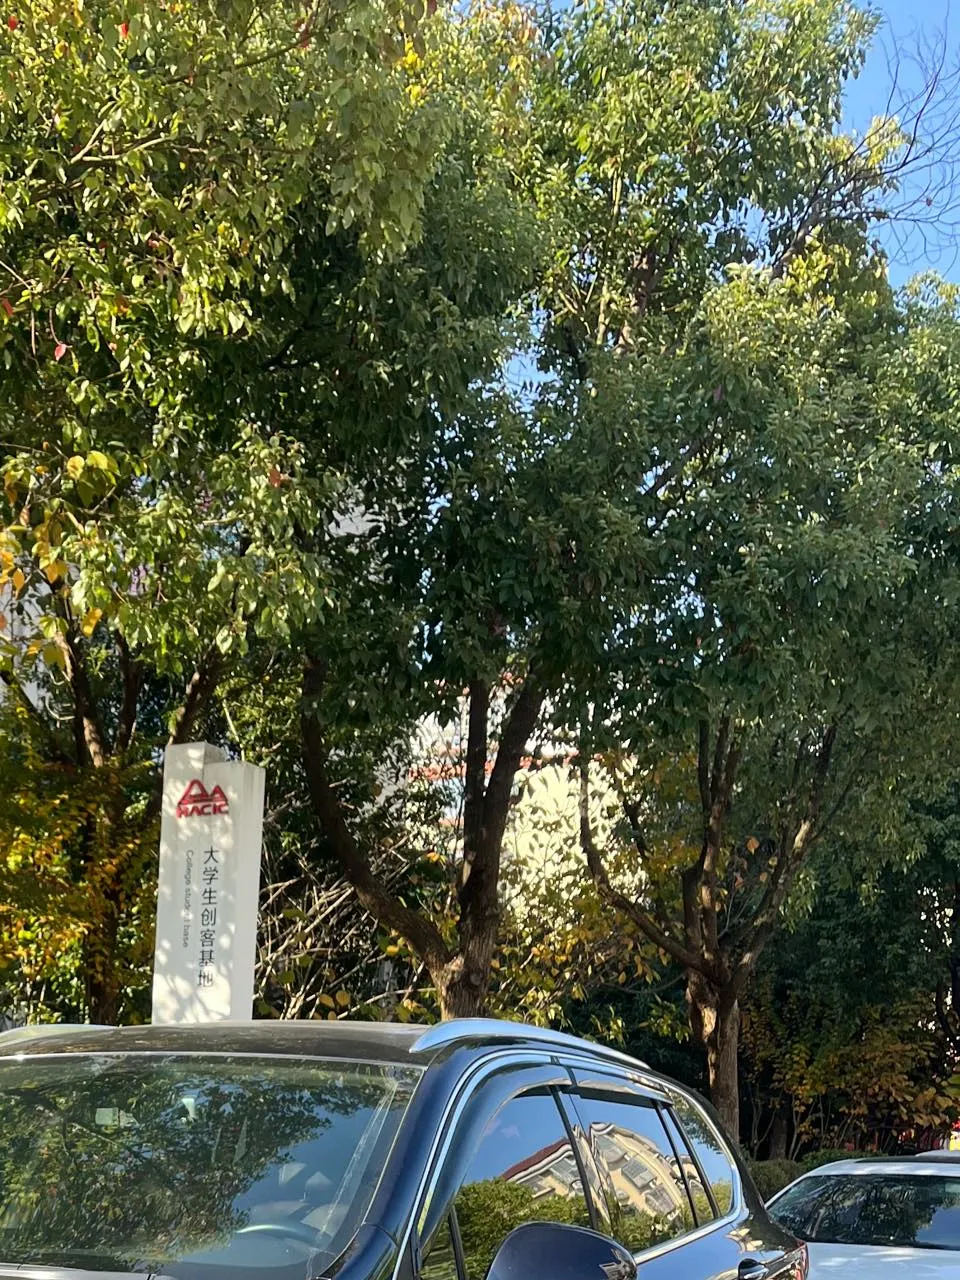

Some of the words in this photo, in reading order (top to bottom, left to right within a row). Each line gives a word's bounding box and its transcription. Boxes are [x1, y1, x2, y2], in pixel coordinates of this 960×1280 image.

[184, 849, 194, 886] College
[198, 845, 220, 988] 大学生创客基地
[182, 924, 191, 948] base
